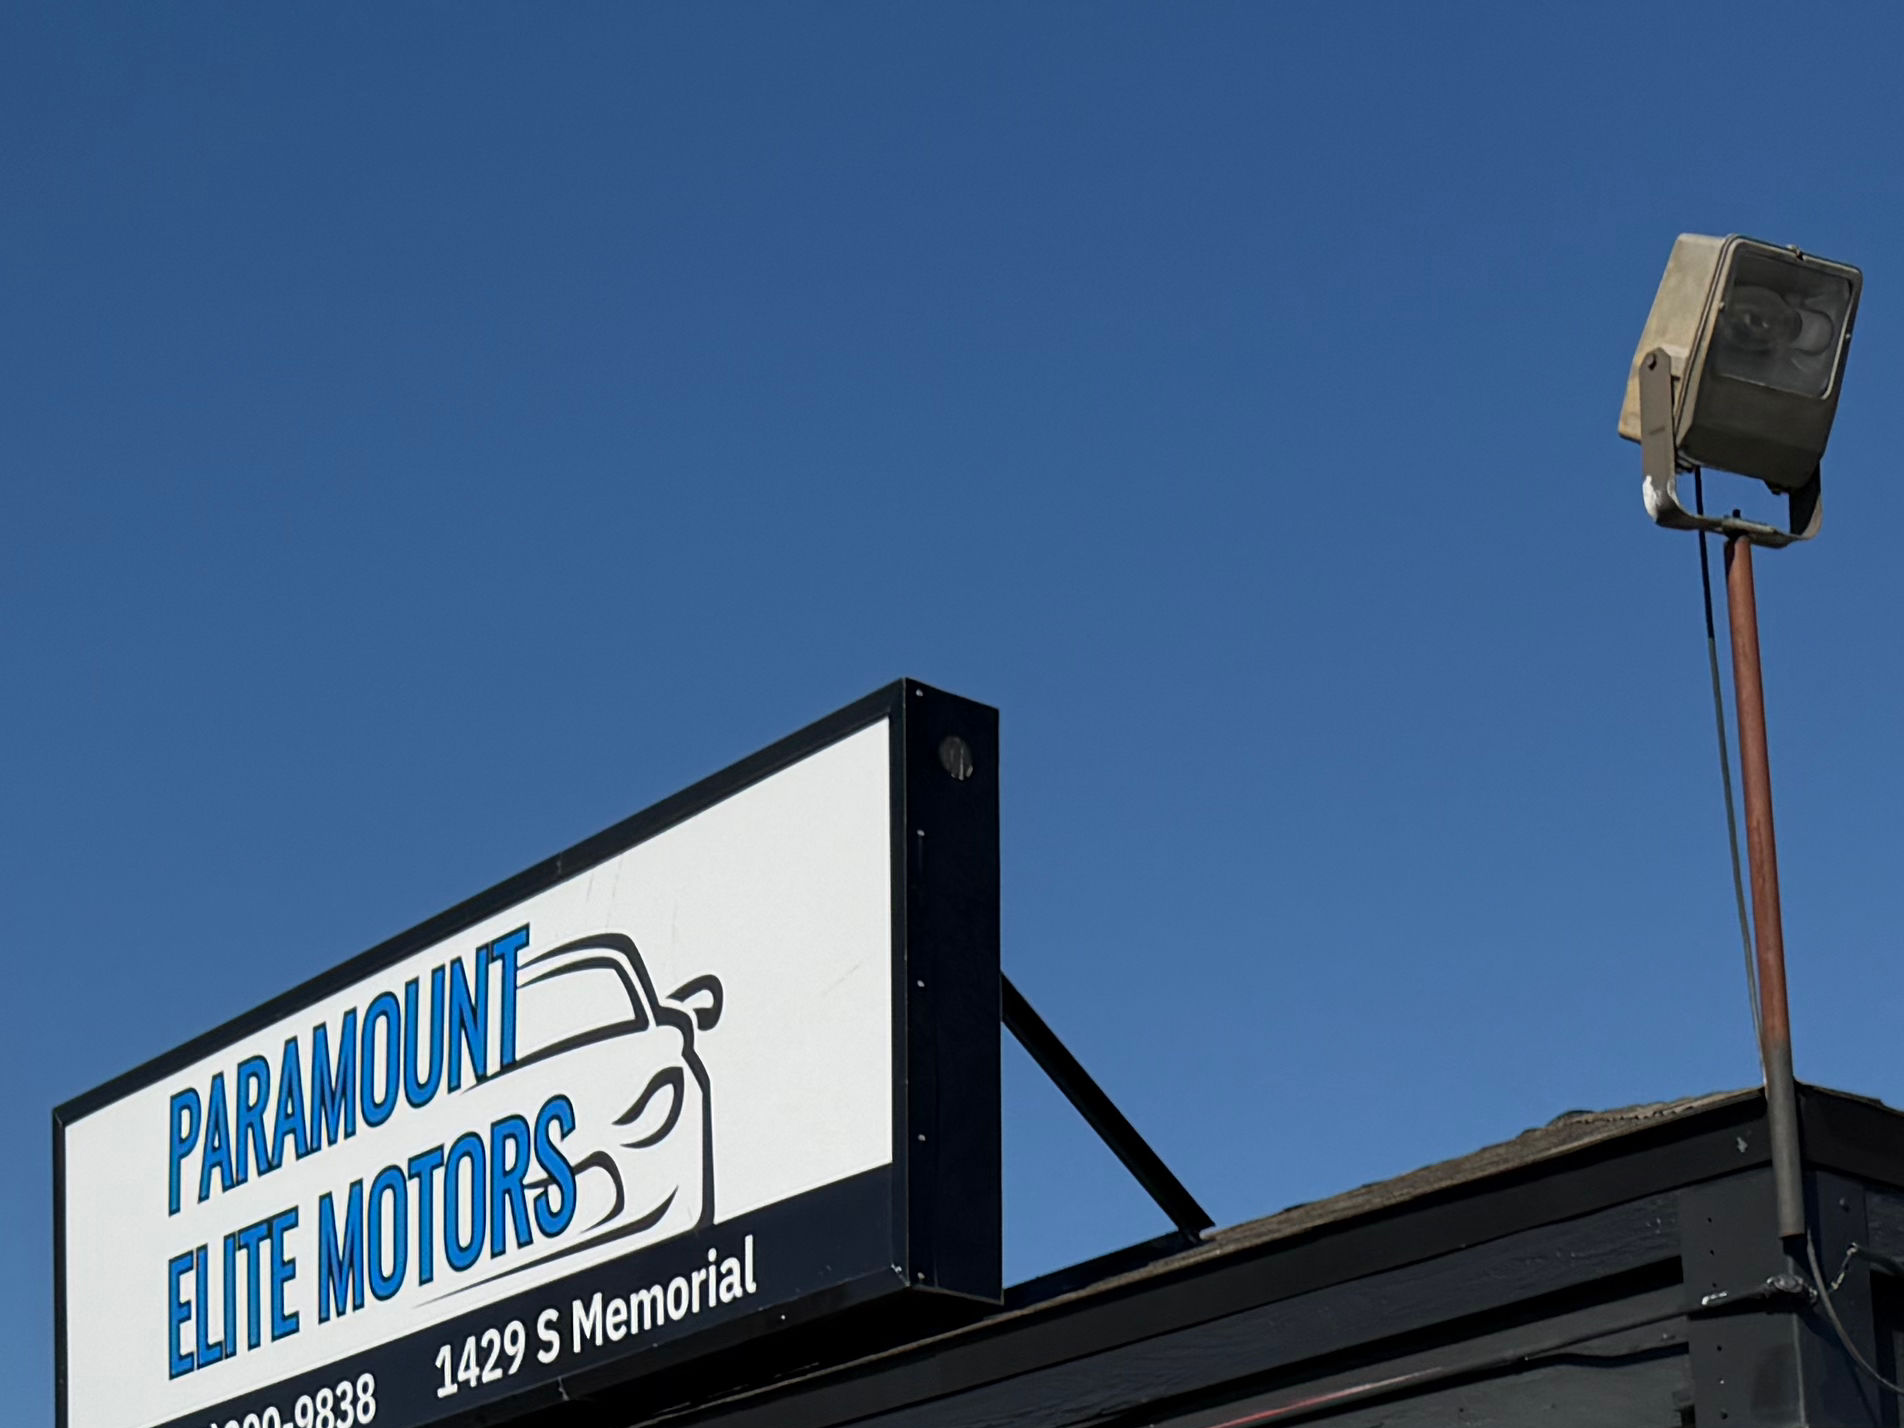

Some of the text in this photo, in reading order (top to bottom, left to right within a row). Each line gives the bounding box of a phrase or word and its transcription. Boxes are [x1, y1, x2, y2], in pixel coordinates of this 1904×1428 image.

[168, 922, 530, 1217] PARAMOUNT
[168, 1094, 577, 1380] ELITE MOTORS
[435, 1235, 757, 1399] 1429 S Memorial
